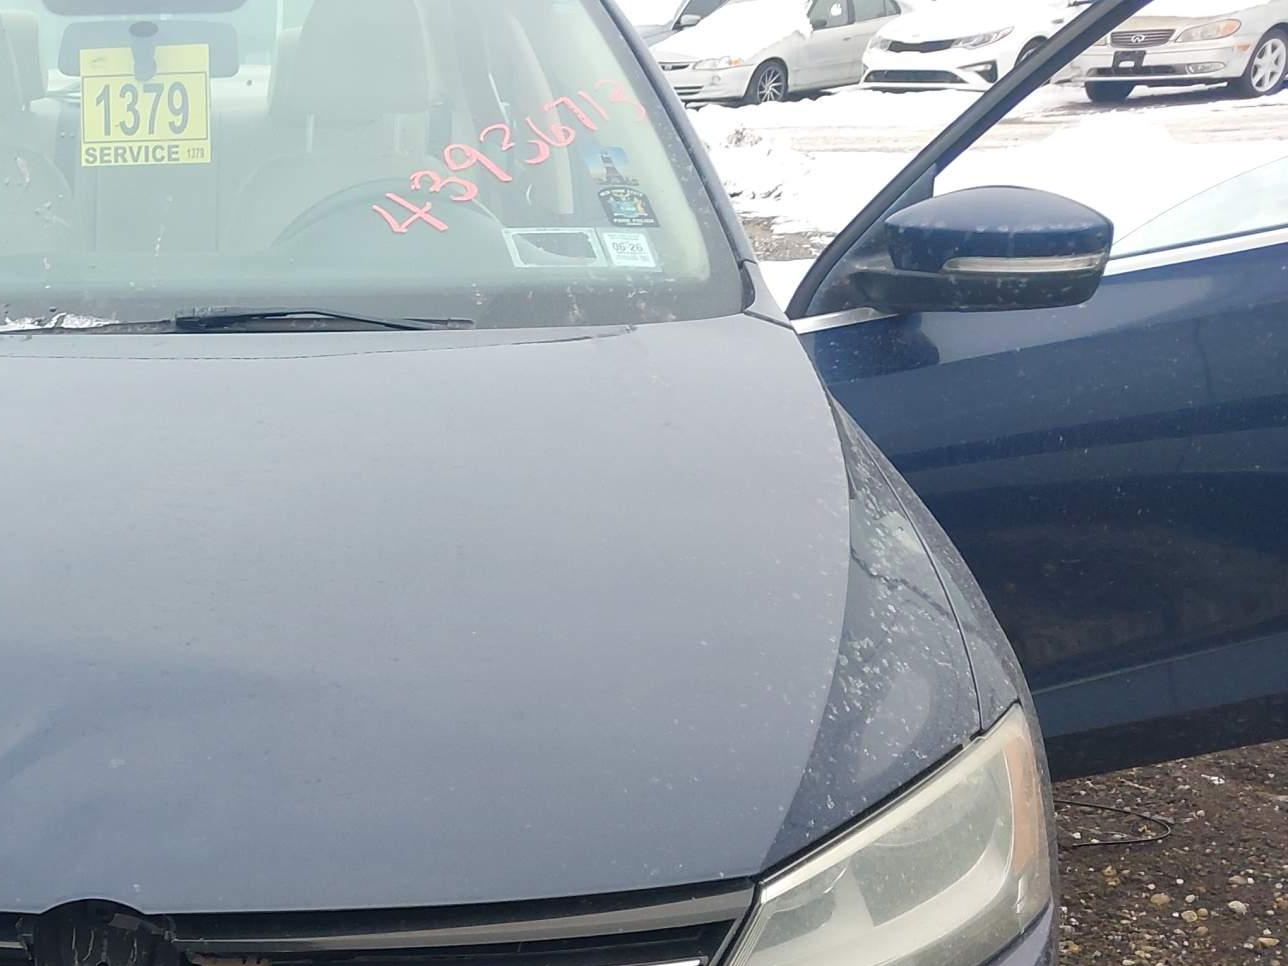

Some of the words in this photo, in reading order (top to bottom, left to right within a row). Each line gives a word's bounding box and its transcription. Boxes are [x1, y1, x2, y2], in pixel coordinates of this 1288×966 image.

[95, 81, 190, 137] 1379
[84, 144, 180, 165] SERVICE
[372, 79, 648, 233] 43936713
